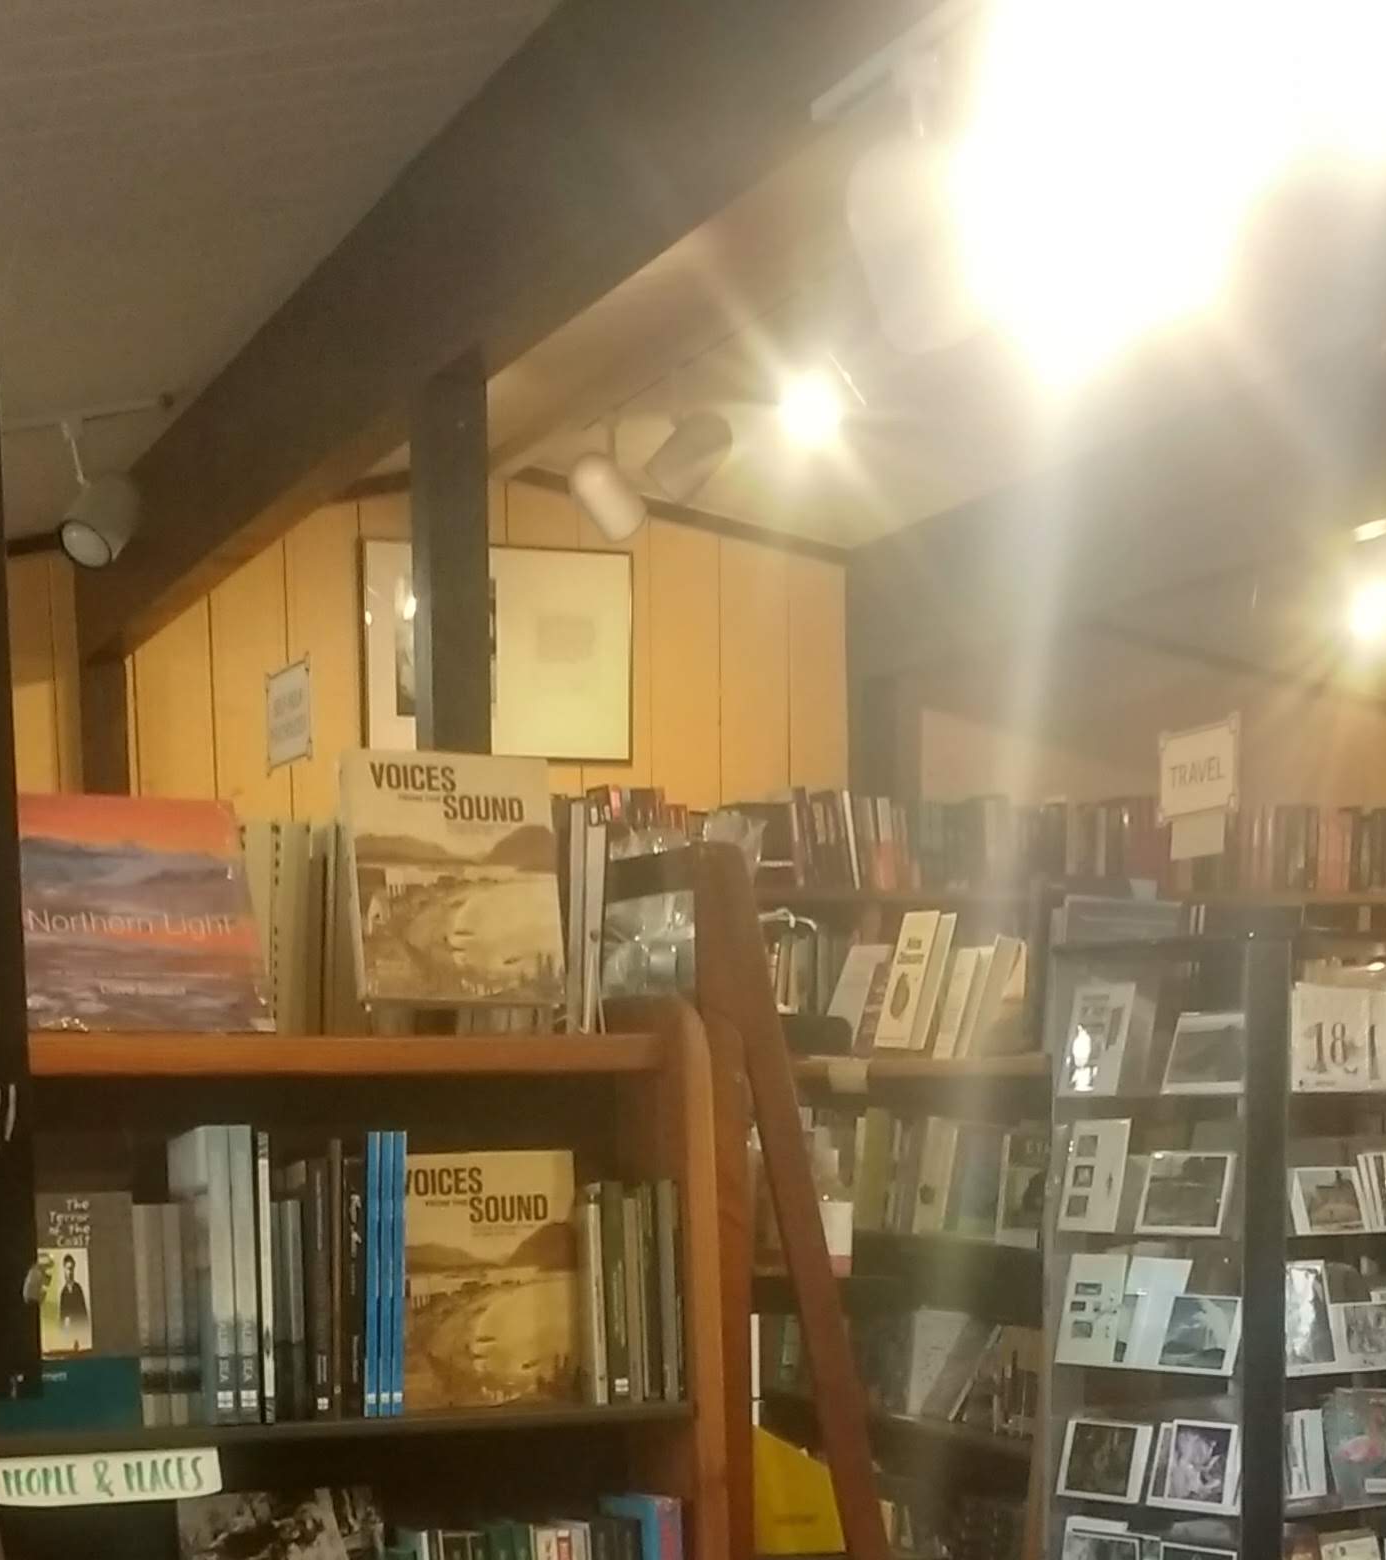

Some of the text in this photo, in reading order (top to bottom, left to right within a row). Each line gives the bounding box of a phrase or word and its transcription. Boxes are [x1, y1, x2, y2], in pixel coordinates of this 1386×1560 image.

[369, 762, 456, 791] VOICES
[1168, 756, 1226, 788] TRAVEL
[442, 795, 525, 822] SOUND
[26, 907, 234, 942] Northern Light
[66, 1198, 90, 1211] The
[469, 1194, 549, 1223] SOUND
[2, 1455, 204, 1497] PEOPLE & PLACES
